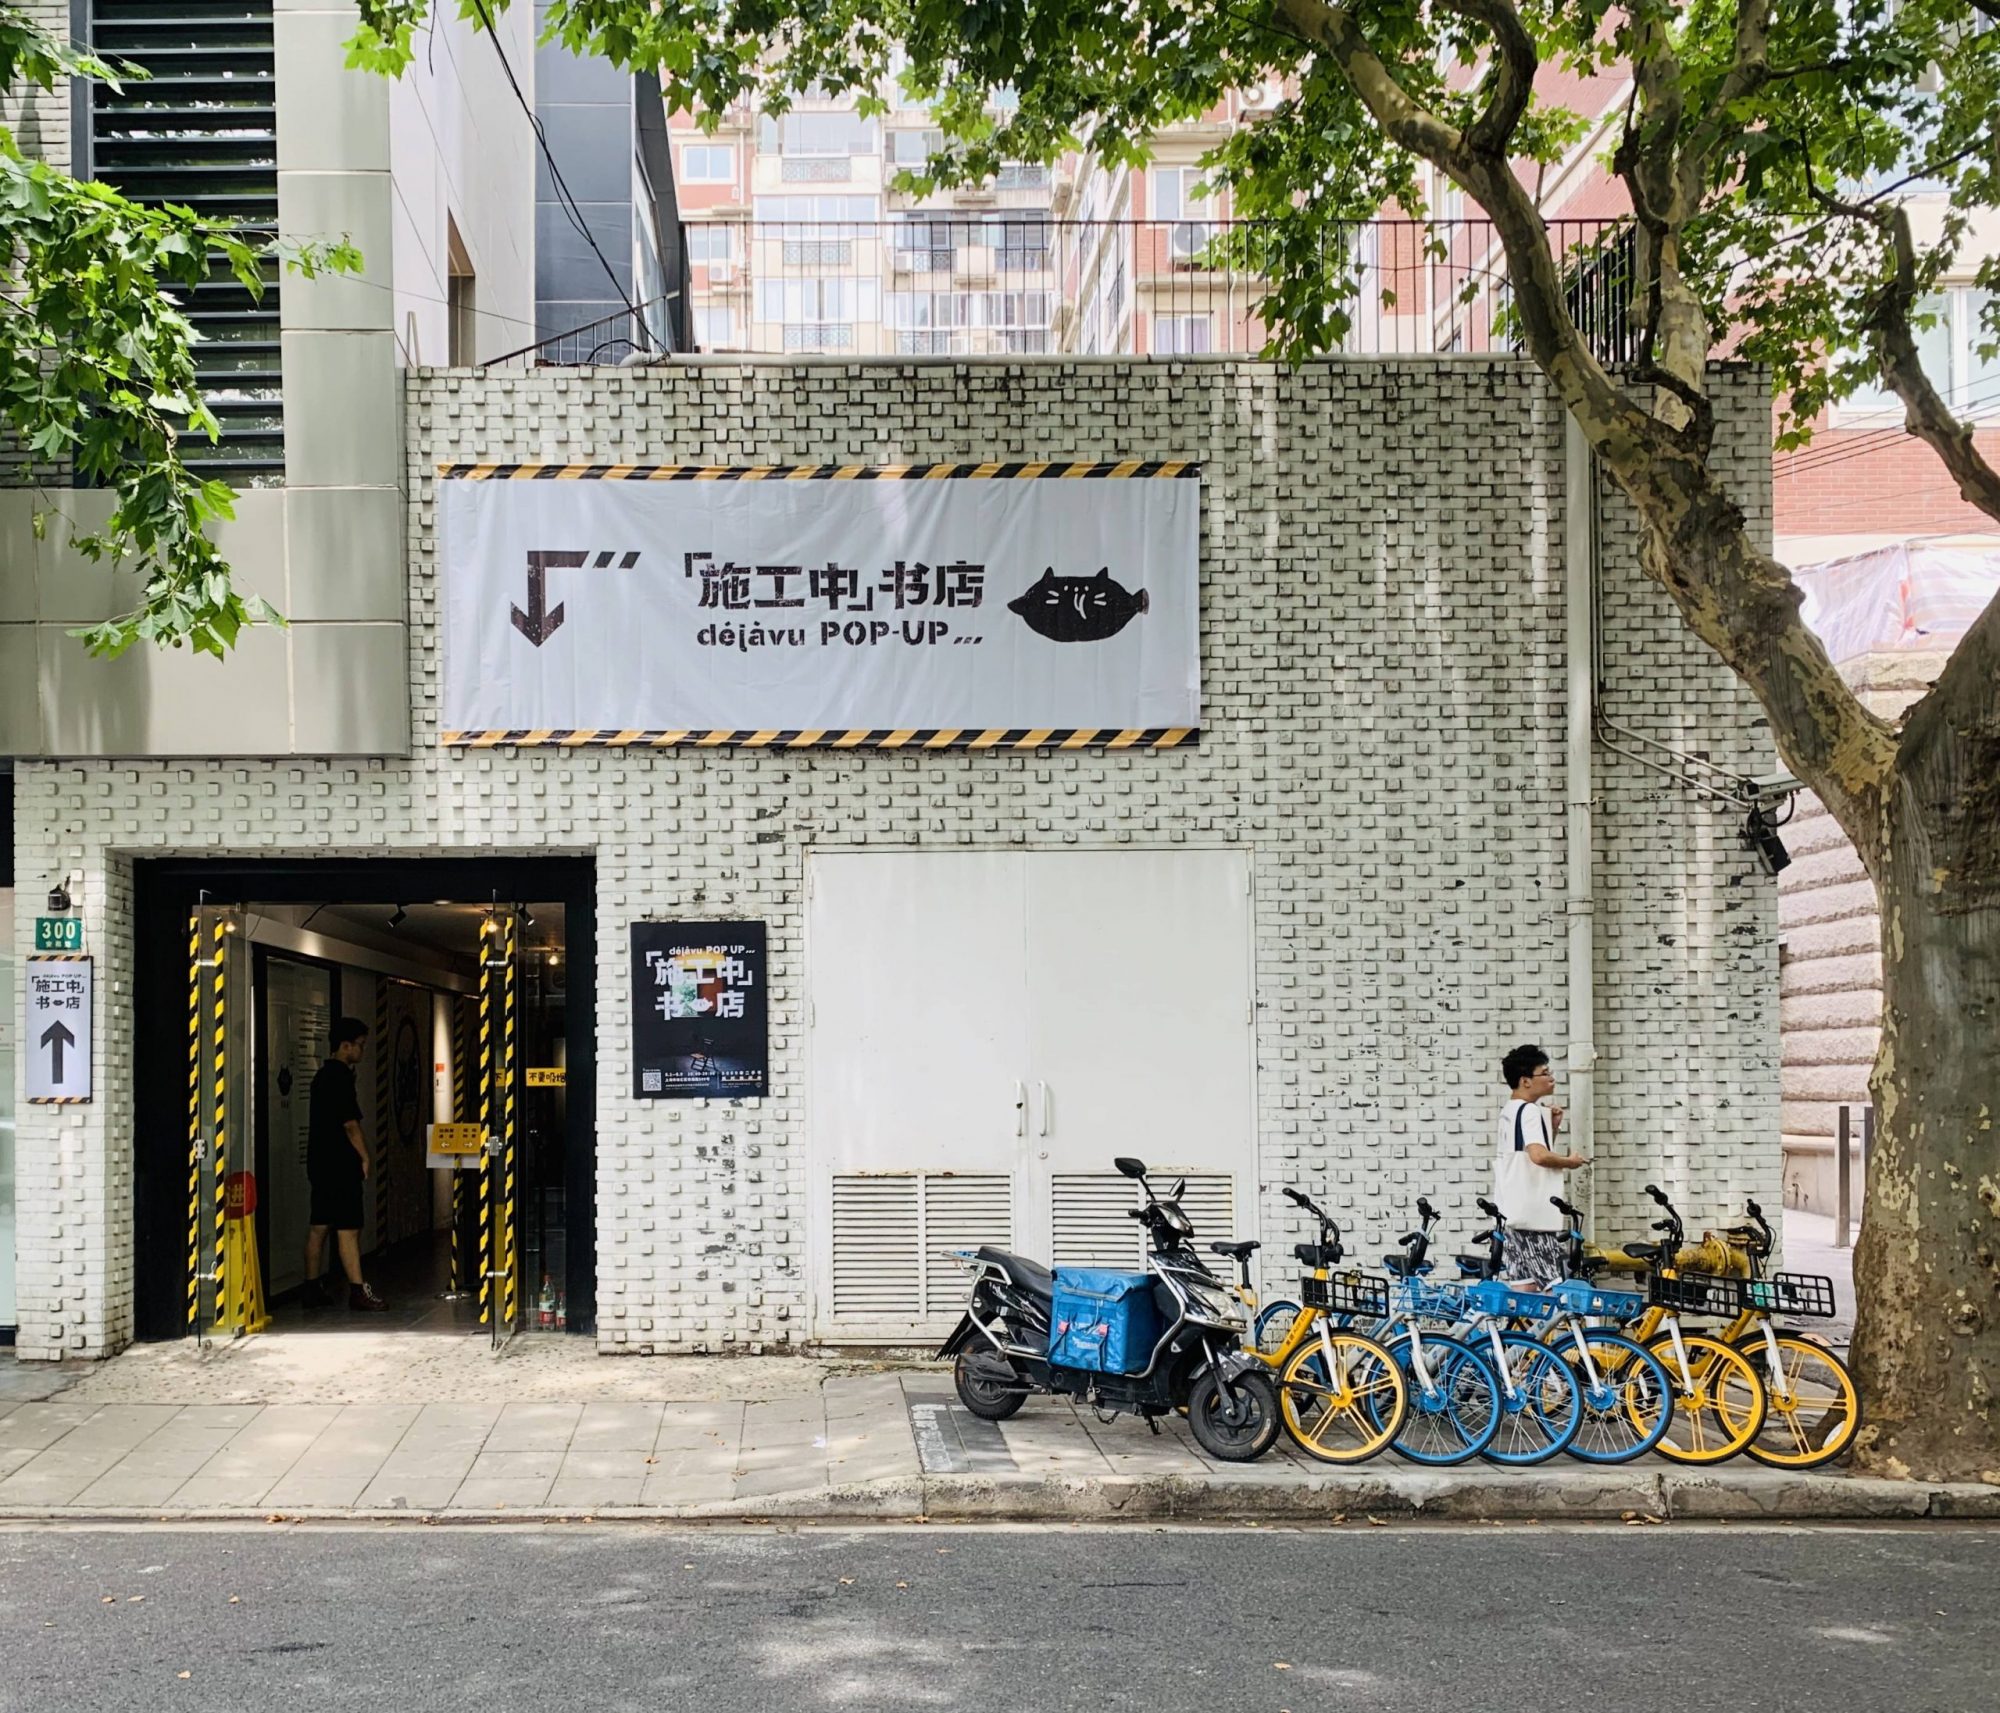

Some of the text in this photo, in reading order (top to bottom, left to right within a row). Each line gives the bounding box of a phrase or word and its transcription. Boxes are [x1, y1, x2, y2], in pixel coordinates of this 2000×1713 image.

[697, 620, 805, 652] déjàvu
[42, 922, 76, 939] 300
[706, 945, 728, 955] POP
